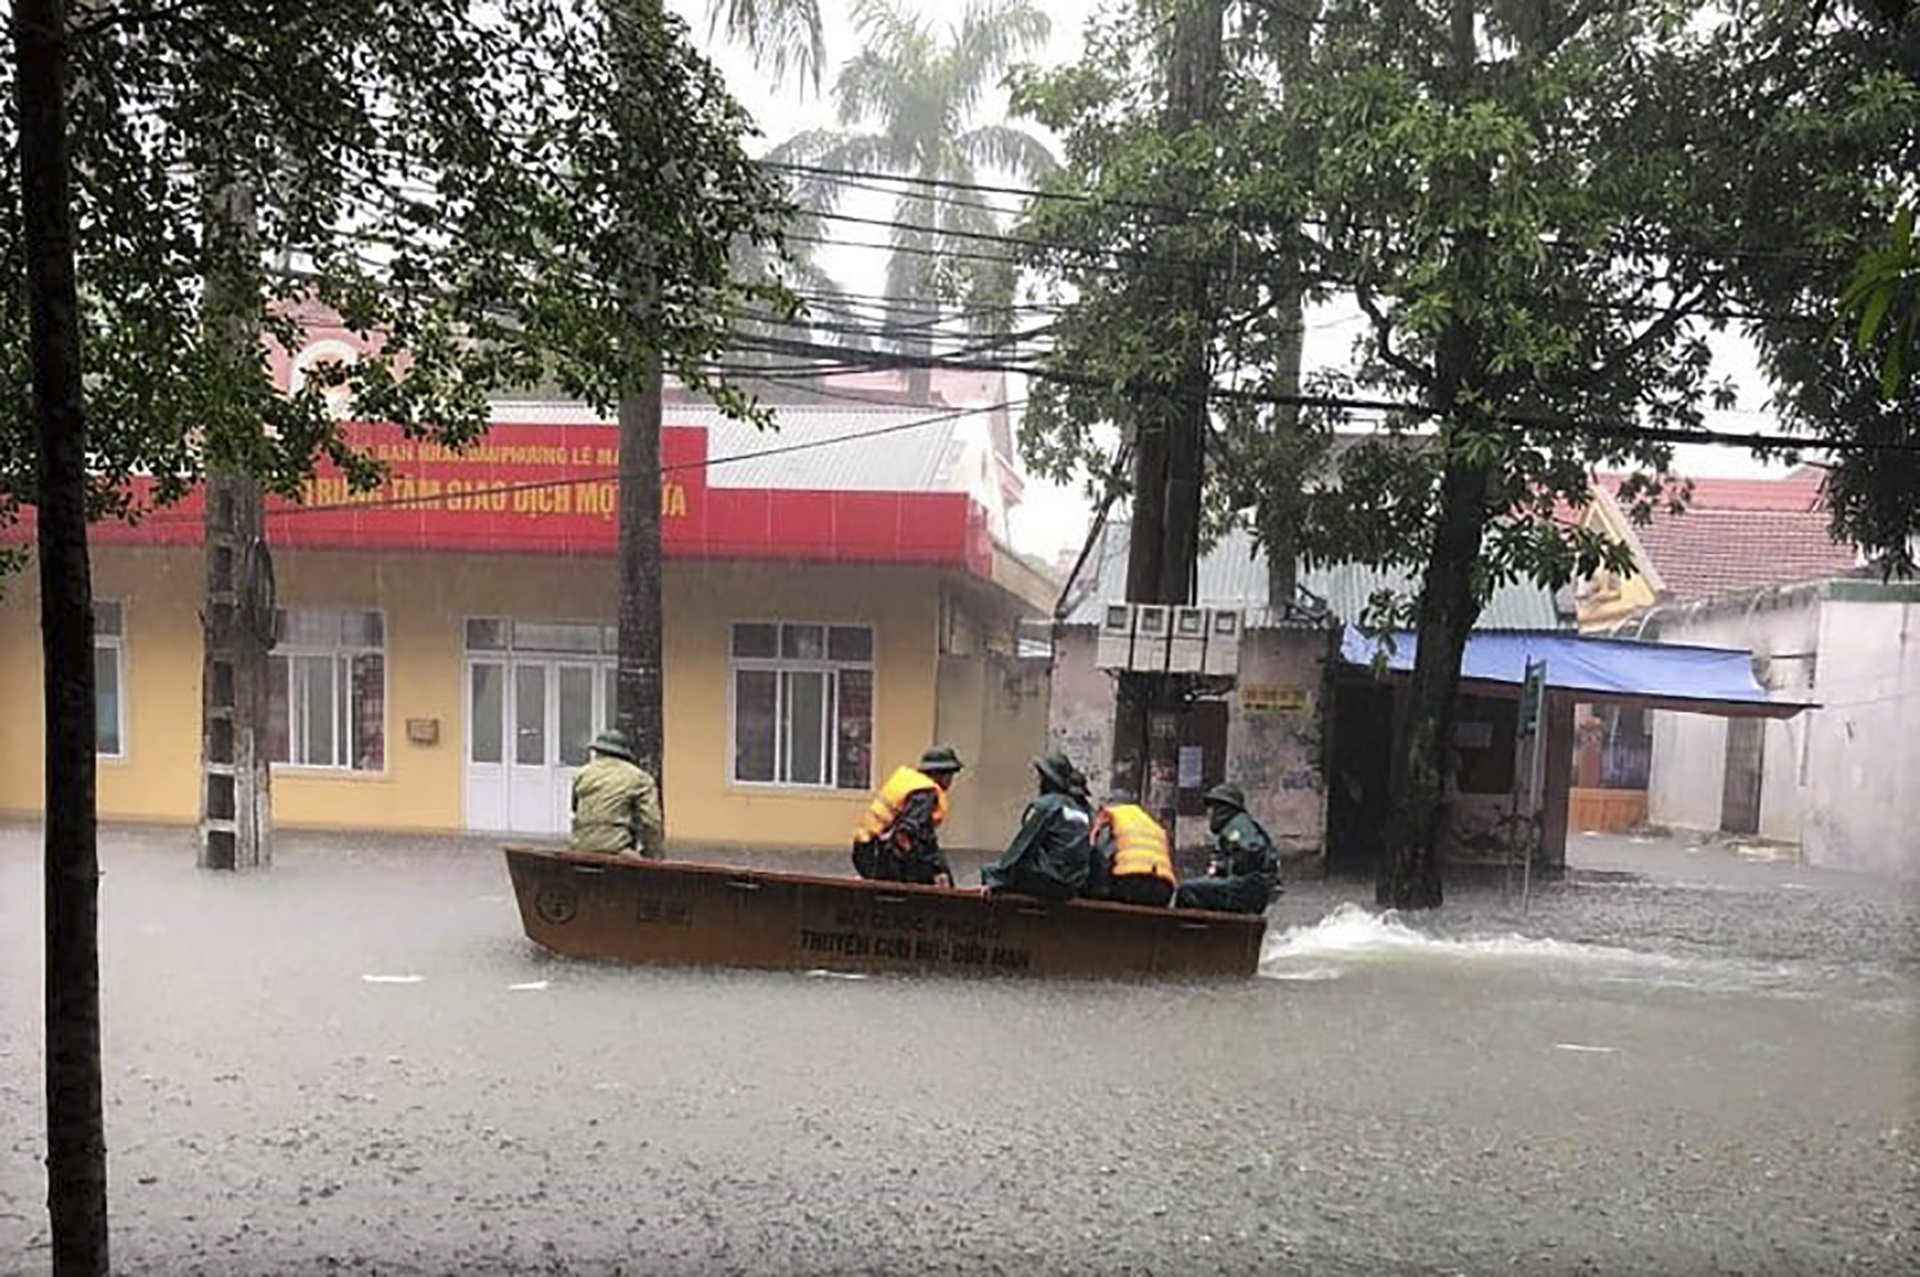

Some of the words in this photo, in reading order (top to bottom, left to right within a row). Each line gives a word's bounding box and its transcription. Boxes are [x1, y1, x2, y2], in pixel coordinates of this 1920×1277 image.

[572, 442, 592, 466] LÊ
[446, 478, 507, 512] GIAO
[513, 481, 572, 519] DỊCH
[575, 477, 620, 521] MỘ
